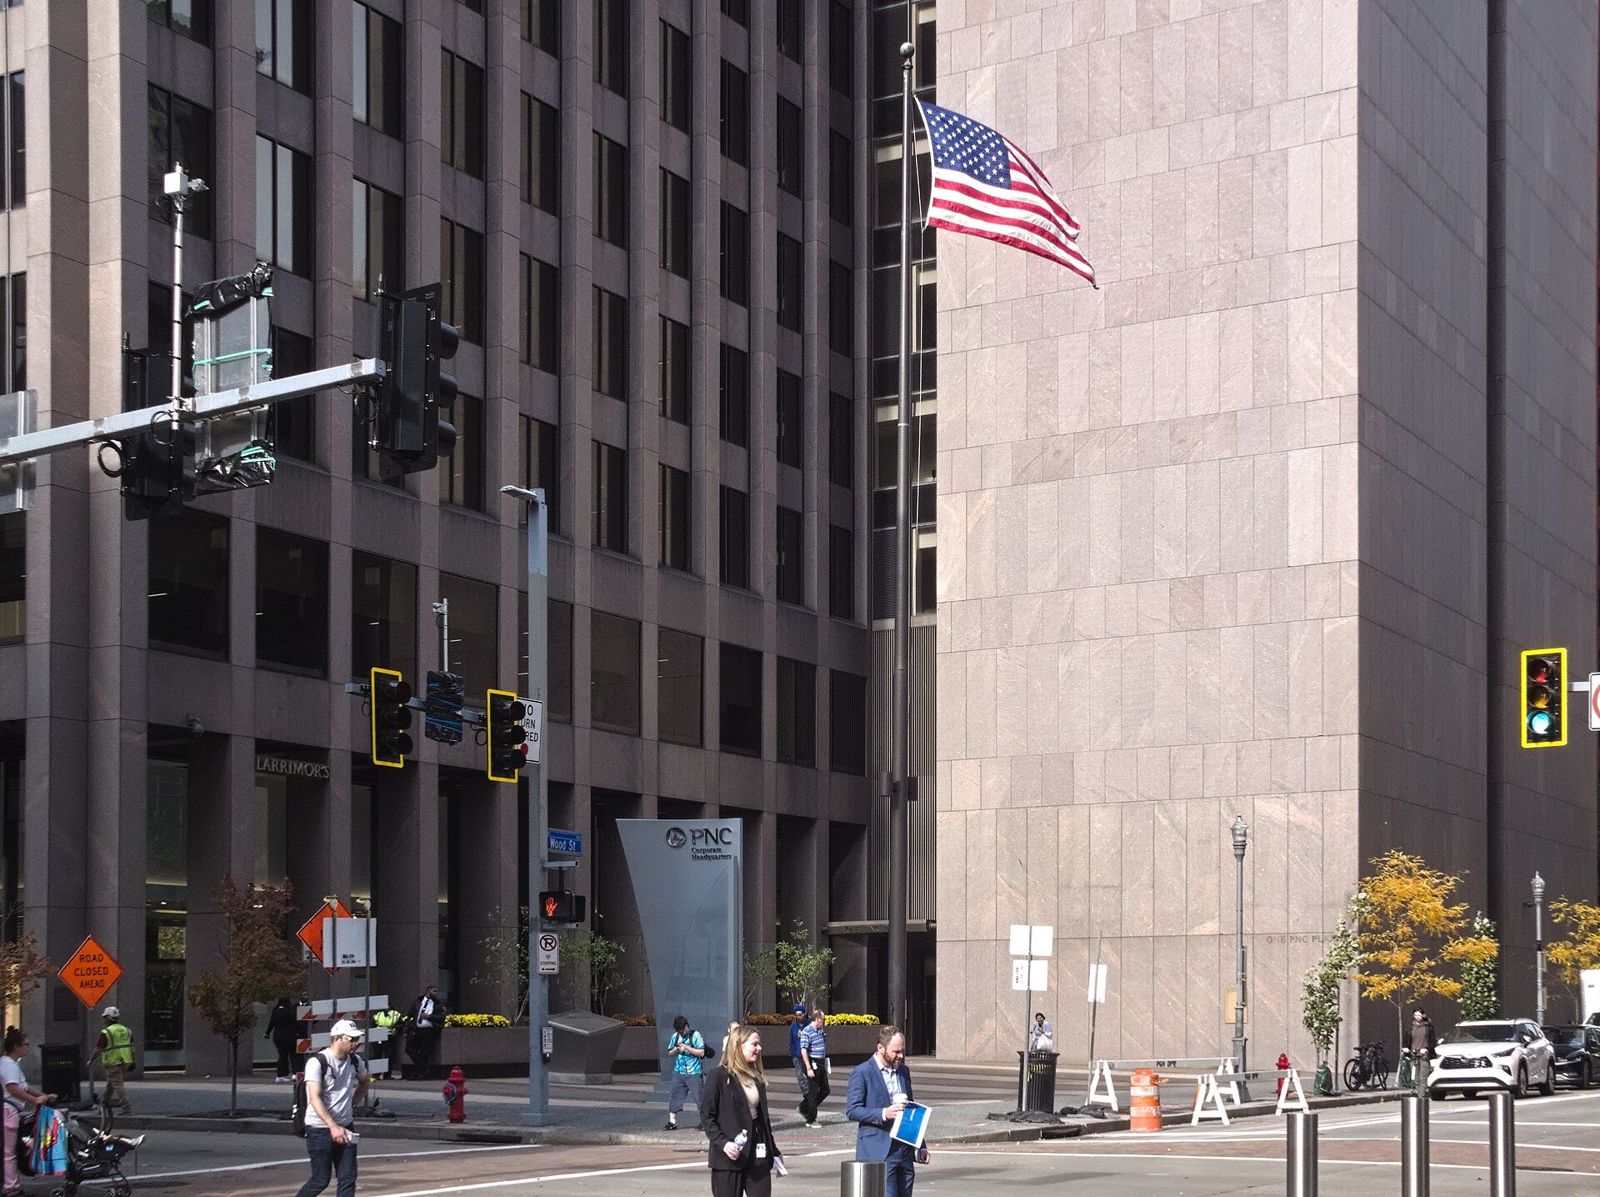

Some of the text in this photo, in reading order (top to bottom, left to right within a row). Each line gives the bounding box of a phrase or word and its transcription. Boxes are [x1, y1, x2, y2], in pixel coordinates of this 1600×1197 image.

[520, 719, 536, 729] URN
[689, 827, 732, 846] PNC
[550, 837, 577, 851] Wood St
[1265, 936, 1286, 944] ONE
[1289, 936, 1309, 944] PNC
[79, 953, 104, 963] ROAD
[74, 966, 109, 977] CLOSED
[80, 979, 105, 989] AHEAD
